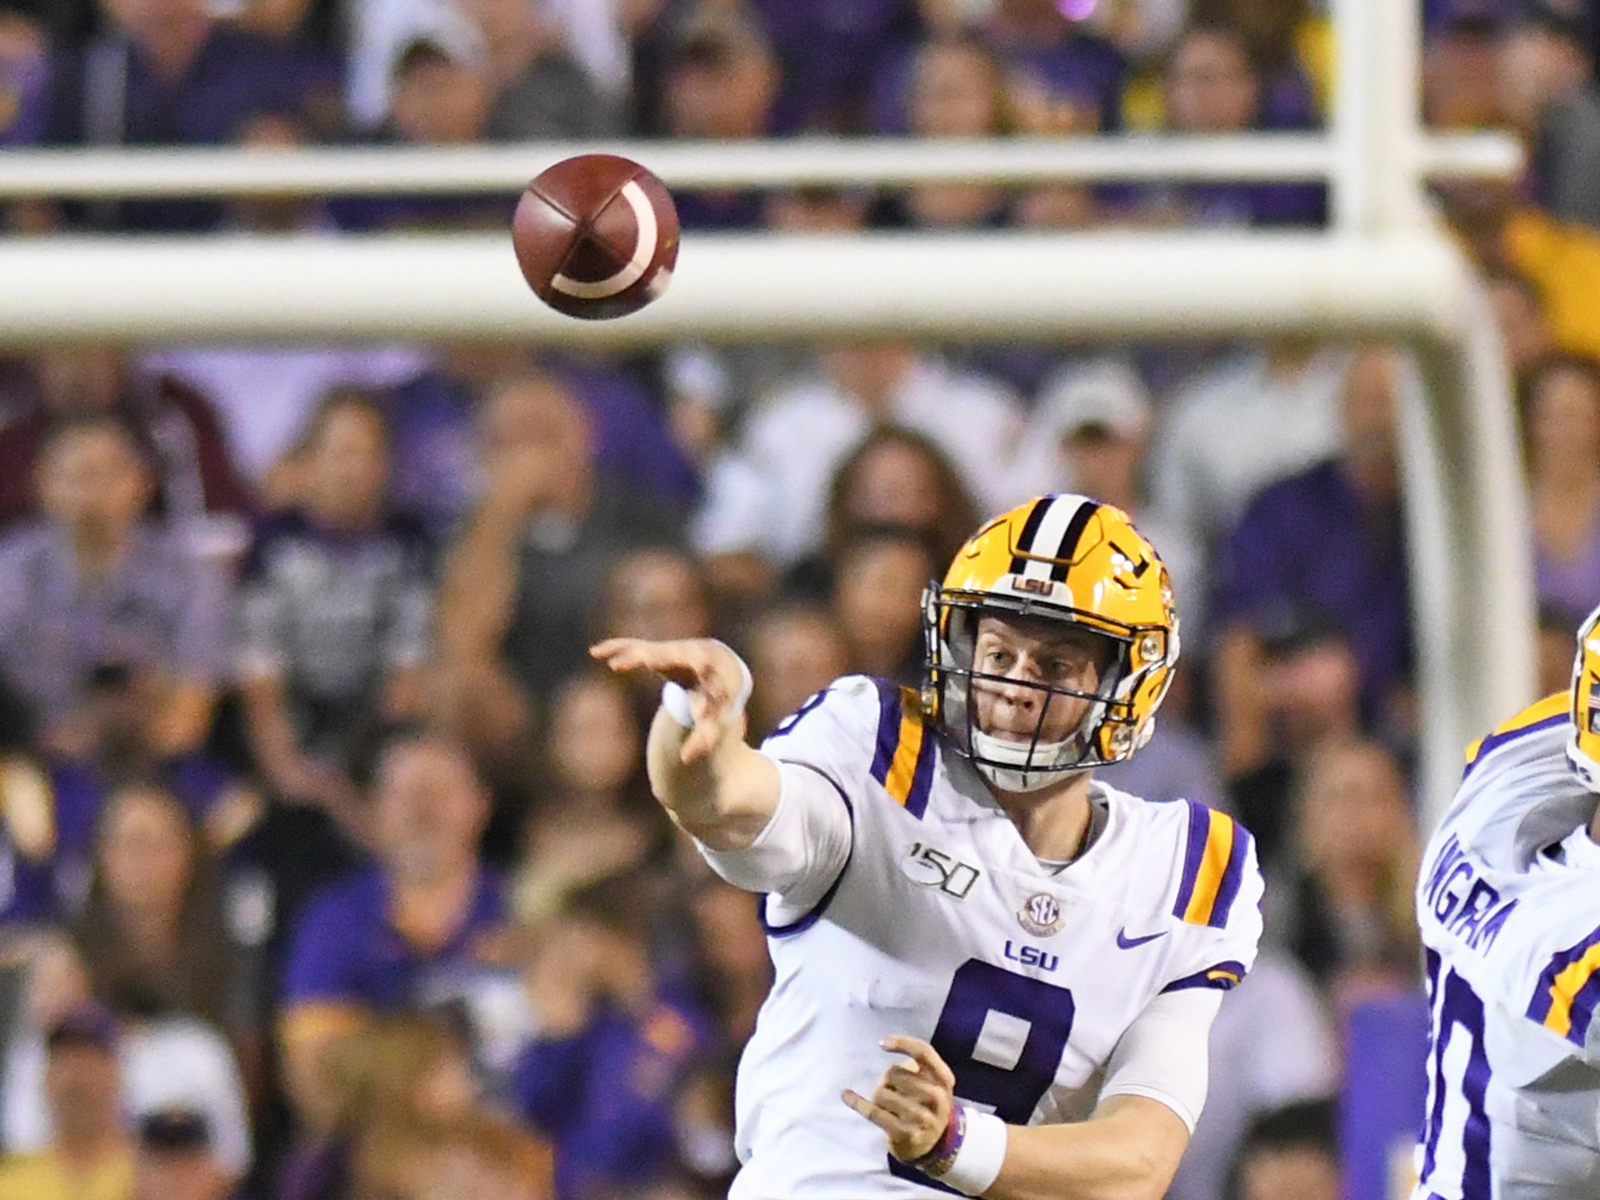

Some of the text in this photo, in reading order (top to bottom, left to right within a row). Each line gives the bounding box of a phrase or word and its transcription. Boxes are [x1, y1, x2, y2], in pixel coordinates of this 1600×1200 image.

[1011, 575, 1054, 597] LSU
[1029, 894, 1059, 926] SEC
[1003, 939, 1060, 973] LSU
